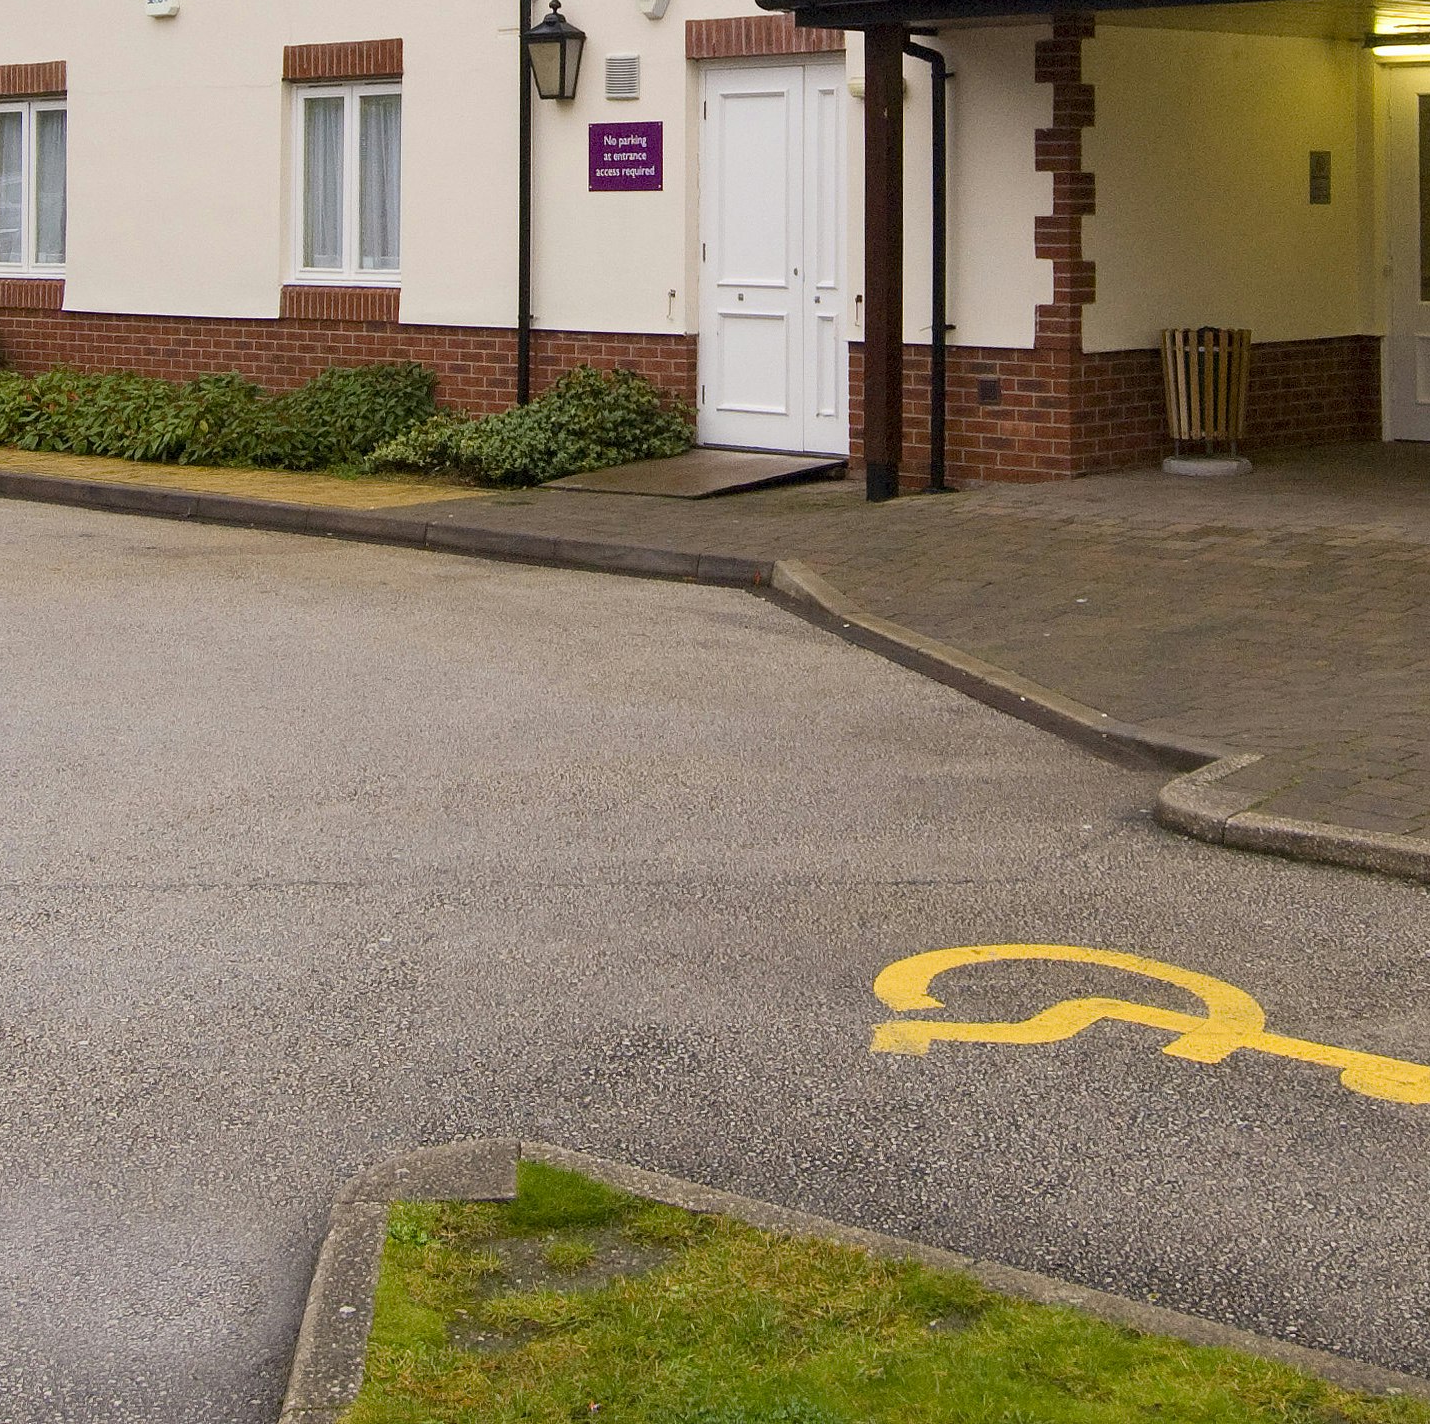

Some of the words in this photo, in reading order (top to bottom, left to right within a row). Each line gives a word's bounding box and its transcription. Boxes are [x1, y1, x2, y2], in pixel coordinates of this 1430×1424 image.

[603, 135, 617, 146] No
[618, 134, 648, 148] parking
[603, 153, 612, 161] at
[613, 152, 647, 161] entrance
[595, 168, 620, 177] access
[621, 165, 655, 178] required
